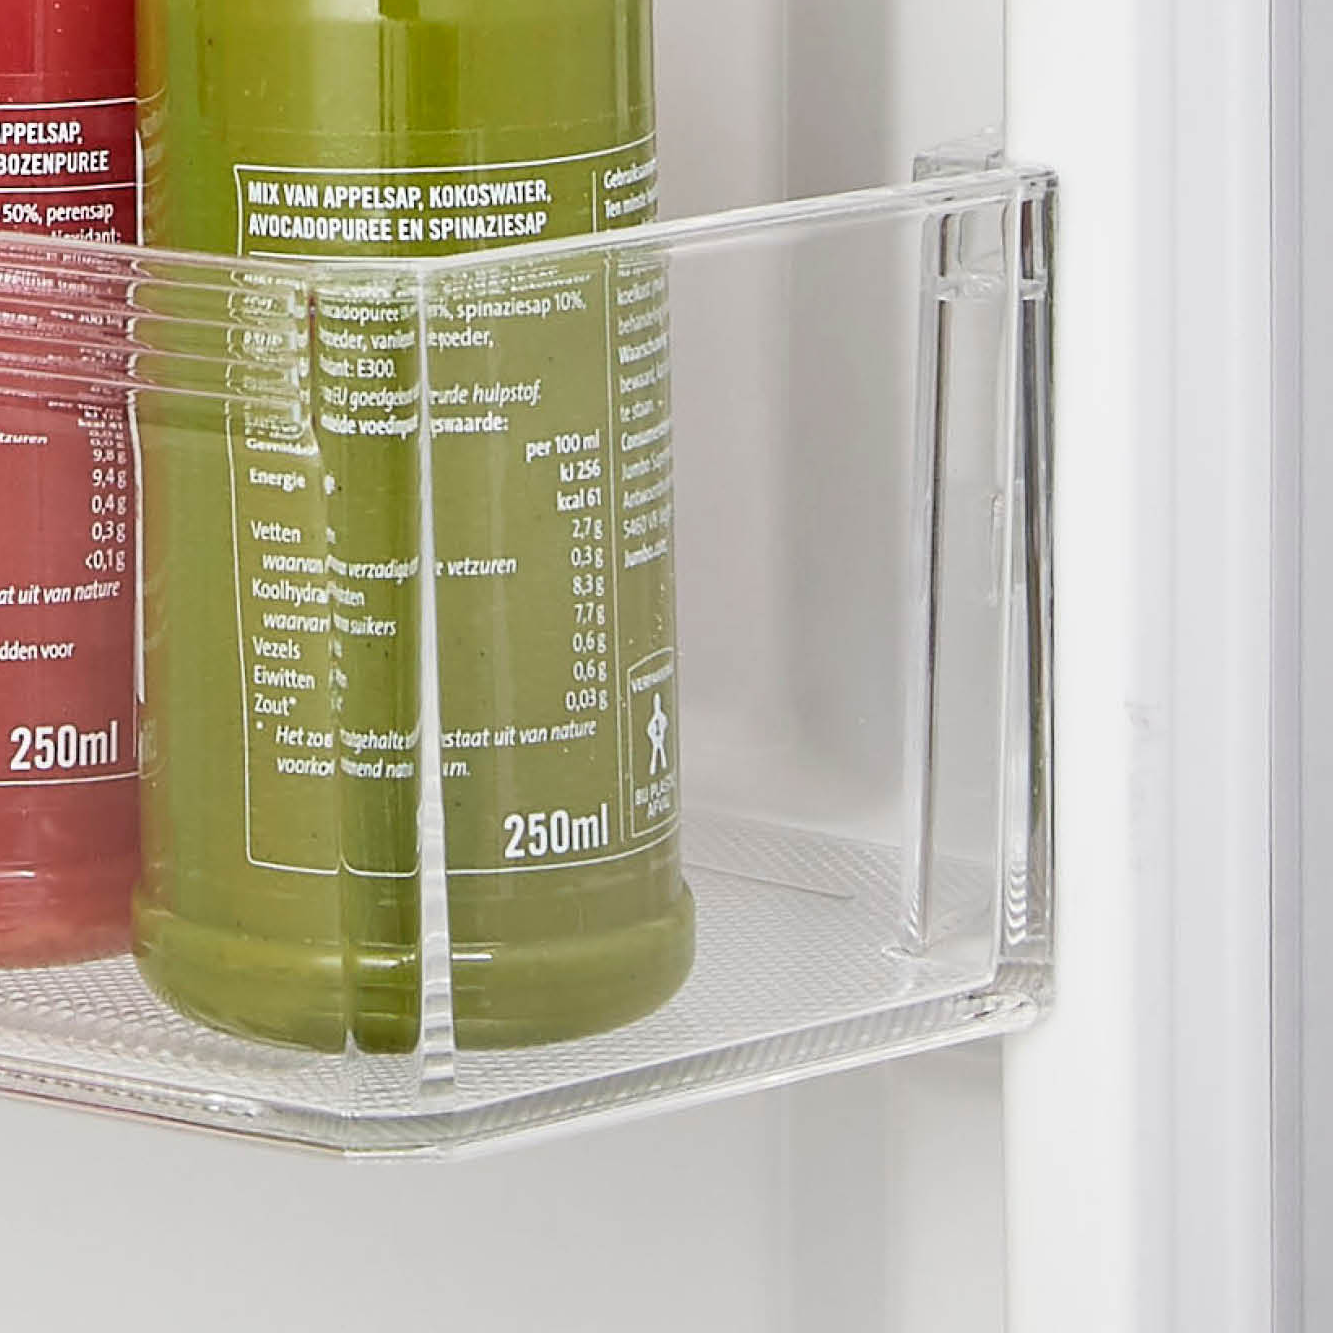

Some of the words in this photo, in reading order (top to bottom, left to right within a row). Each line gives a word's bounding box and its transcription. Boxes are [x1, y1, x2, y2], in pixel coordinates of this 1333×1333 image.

[247, 180, 281, 205] MIX
[284, 184, 319, 207] VAN
[322, 185, 424, 211] APPELSAP,
[429, 179, 551, 209] KOKOSWATER,
[2, 203, 42, 225] 50%,
[46, 204, 113, 226] perensap
[248, 214, 392, 241] AVOCADOPUREE
[398, 216, 423, 241] EN
[429, 213, 547, 240] SPINAZIESAP
[456, 295, 552, 319] spinaziesap
[553, 292, 587, 314] 10%,
[356, 360, 397, 378] E300.
[473, 380, 542, 407] hulpstof.
[525, 439, 553, 462] per
[554, 432, 581, 453] 100
[582, 429, 600, 449] ml
[93, 469, 115, 486] 9,4
[117, 471, 127, 488] g
[249, 469, 306, 491] Energie
[559, 462, 577, 480] kJ
[577, 461, 601, 479] 256
[91, 496, 115, 515] 0,4
[117, 497, 126, 515] g
[556, 491, 587, 512] kcal
[587, 489, 602, 508] 61
[91, 523, 115, 541] 0,3
[116, 524, 126, 542] g
[251, 522, 301, 544] Vetten
[572, 519, 593, 539] 2,7
[593, 521, 603, 540] g
[115, 552, 126, 570] g
[447, 557, 517, 575] vetzuren
[571, 548, 593, 568] 0,3
[593, 549, 603, 569] g
[18, 587, 40, 605] uit
[44, 585, 71, 603] van
[74, 579, 120, 600] nature
[572, 578, 594, 596] 8,3
[594, 579, 604, 599] g
[350, 617, 396, 637] suikers
[573, 604, 594, 624] 7,7
[594, 607, 605, 626] g
[40, 642, 74, 659] voor
[252, 638, 301, 660] Vezels
[572, 634, 595, 654] 0,6
[595, 635, 606, 655] g
[253, 666, 316, 690] Eiwitten
[572, 662, 596, 682] 0,6
[596, 663, 607, 683] g
[565, 692, 596, 713] 0,03
[597, 692, 607, 712] g
[10, 721, 118, 771] 250ml
[275, 726, 303, 745] Het
[494, 728, 516, 747] uit
[520, 726, 548, 744] van
[551, 721, 597, 741] nature
[503, 804, 609, 859] 250ml
